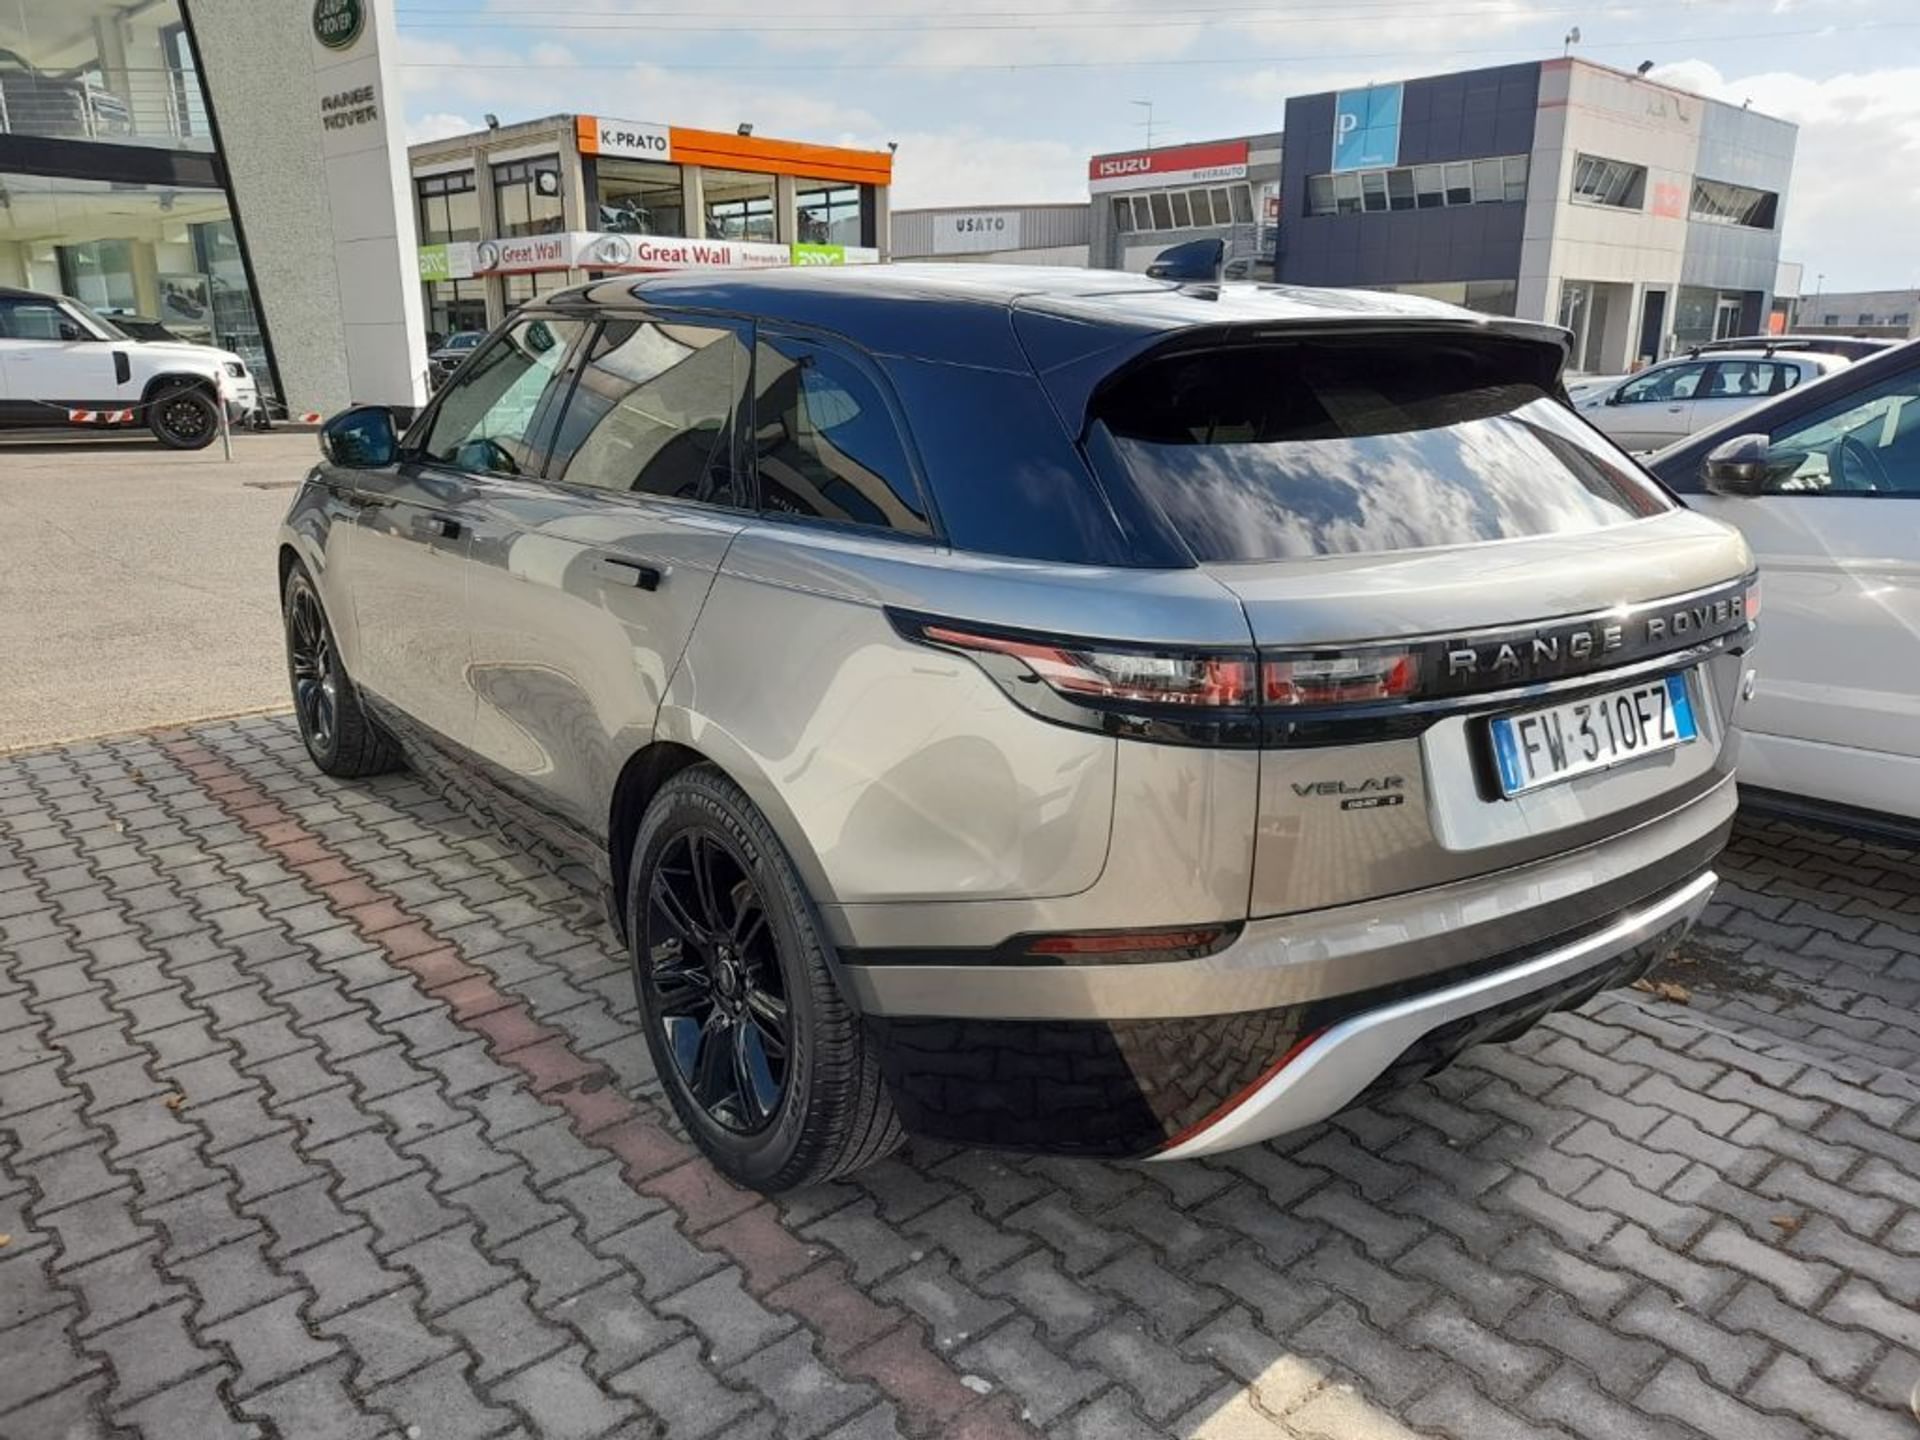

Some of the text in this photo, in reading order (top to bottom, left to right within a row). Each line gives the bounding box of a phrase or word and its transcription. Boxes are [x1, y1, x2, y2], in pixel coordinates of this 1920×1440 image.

[322, 12, 352, 34] ROVER
[322, 85, 375, 111] RANGE
[323, 105, 377, 131] ROVER
[601, 130, 667, 151] K-PRATO
[1099, 157, 1151, 176] ISUZU
[1193, 165, 1245, 180] RIVERAUTO
[956, 217, 1005, 232] USATO
[502, 240, 562, 263] Great Wall
[638, 243, 731, 264] Great Wall
[1449, 595, 1742, 676] RANGE ROVER
[1518, 685, 1676, 779] FW 310FZ
[1290, 775, 1404, 798] VELAR
